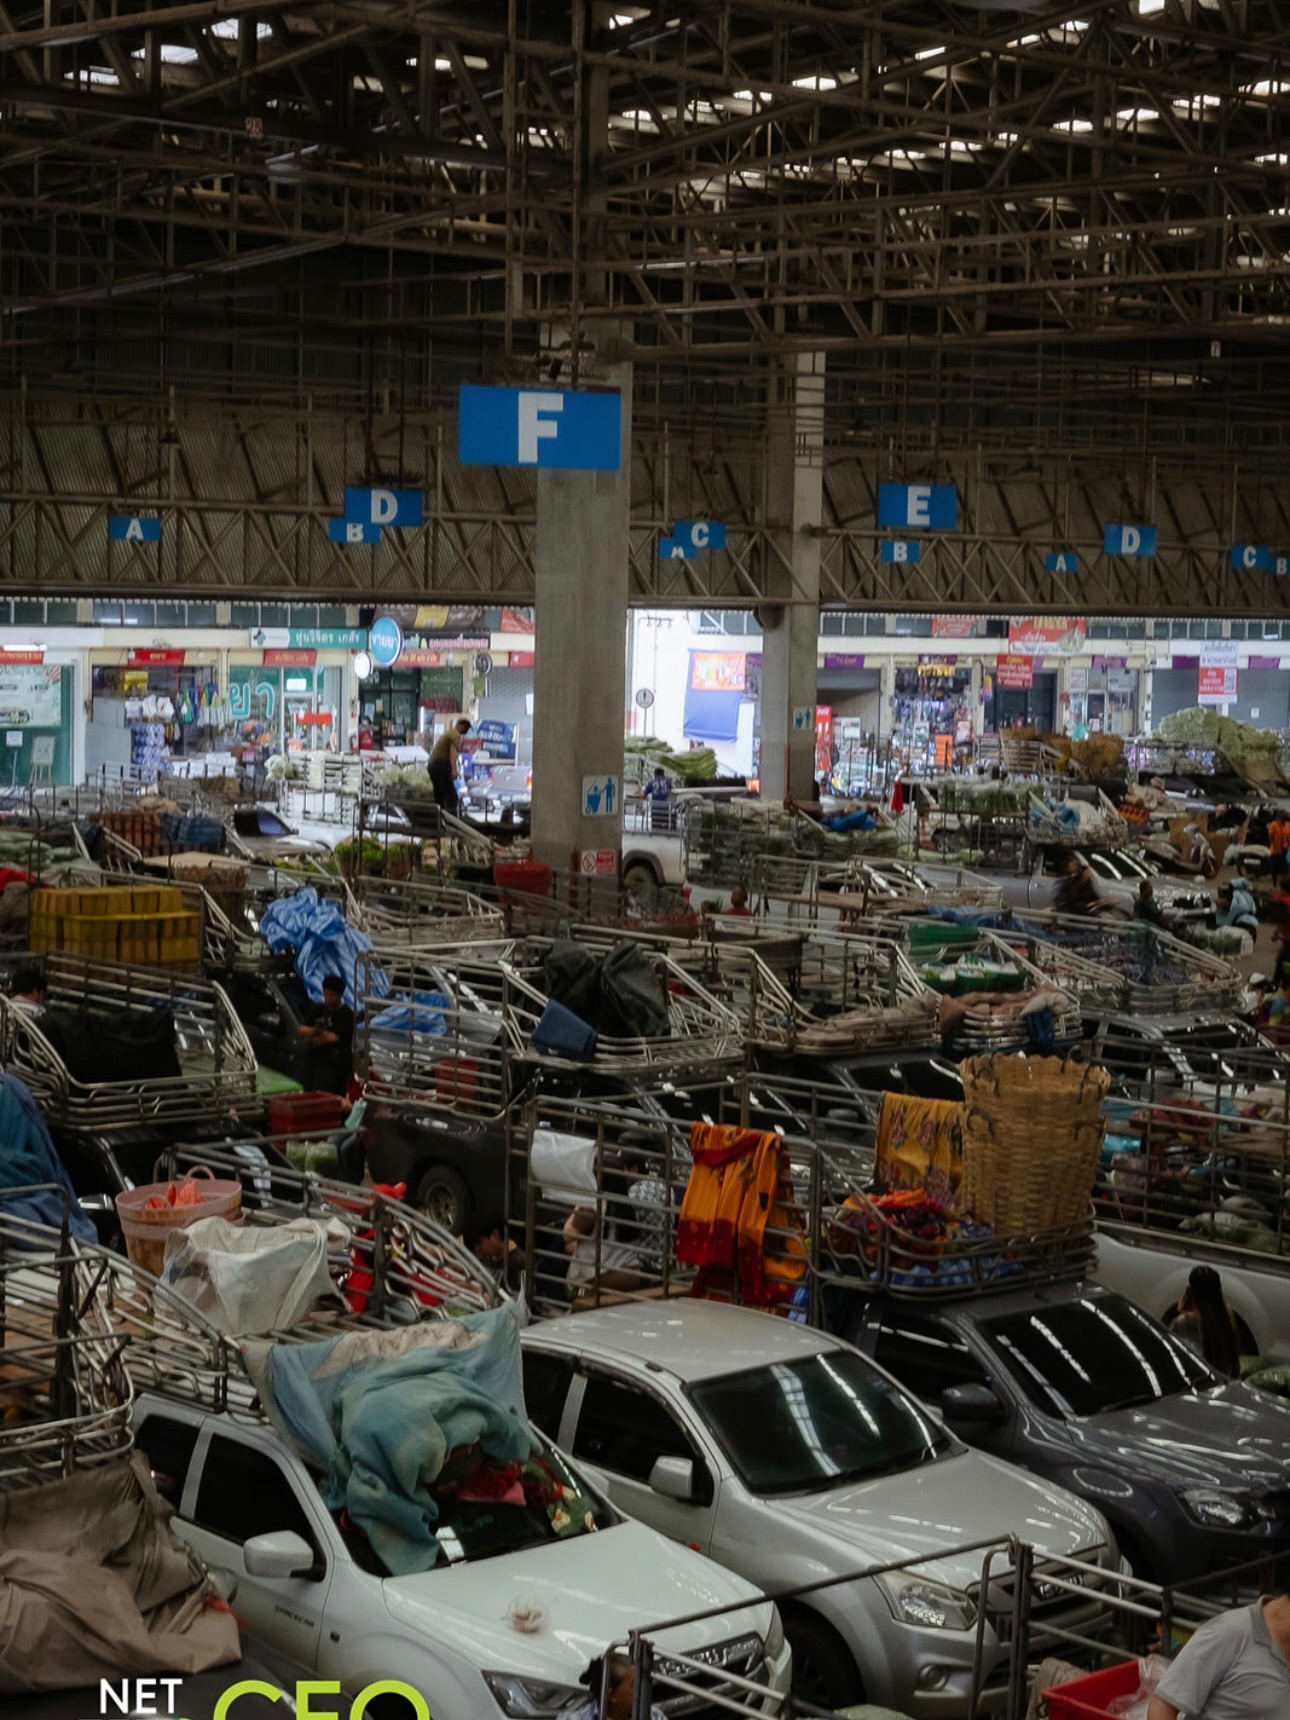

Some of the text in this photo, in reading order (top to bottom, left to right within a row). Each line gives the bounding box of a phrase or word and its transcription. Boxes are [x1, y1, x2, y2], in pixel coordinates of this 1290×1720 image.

[518, 392, 564, 463] F
[370, 489, 398, 525] D
[907, 486, 931, 527] E
[126, 518, 143, 540] A
[346, 522, 364, 543] B
[691, 522, 709, 548] C
[1121, 526, 1141, 555] D
[893, 541, 908, 562] B
[1055, 554, 1067, 572] A
[1243, 545, 1257, 568] C
[1276, 557, 1288, 576] B
[230, 682, 275, 719] ยา
